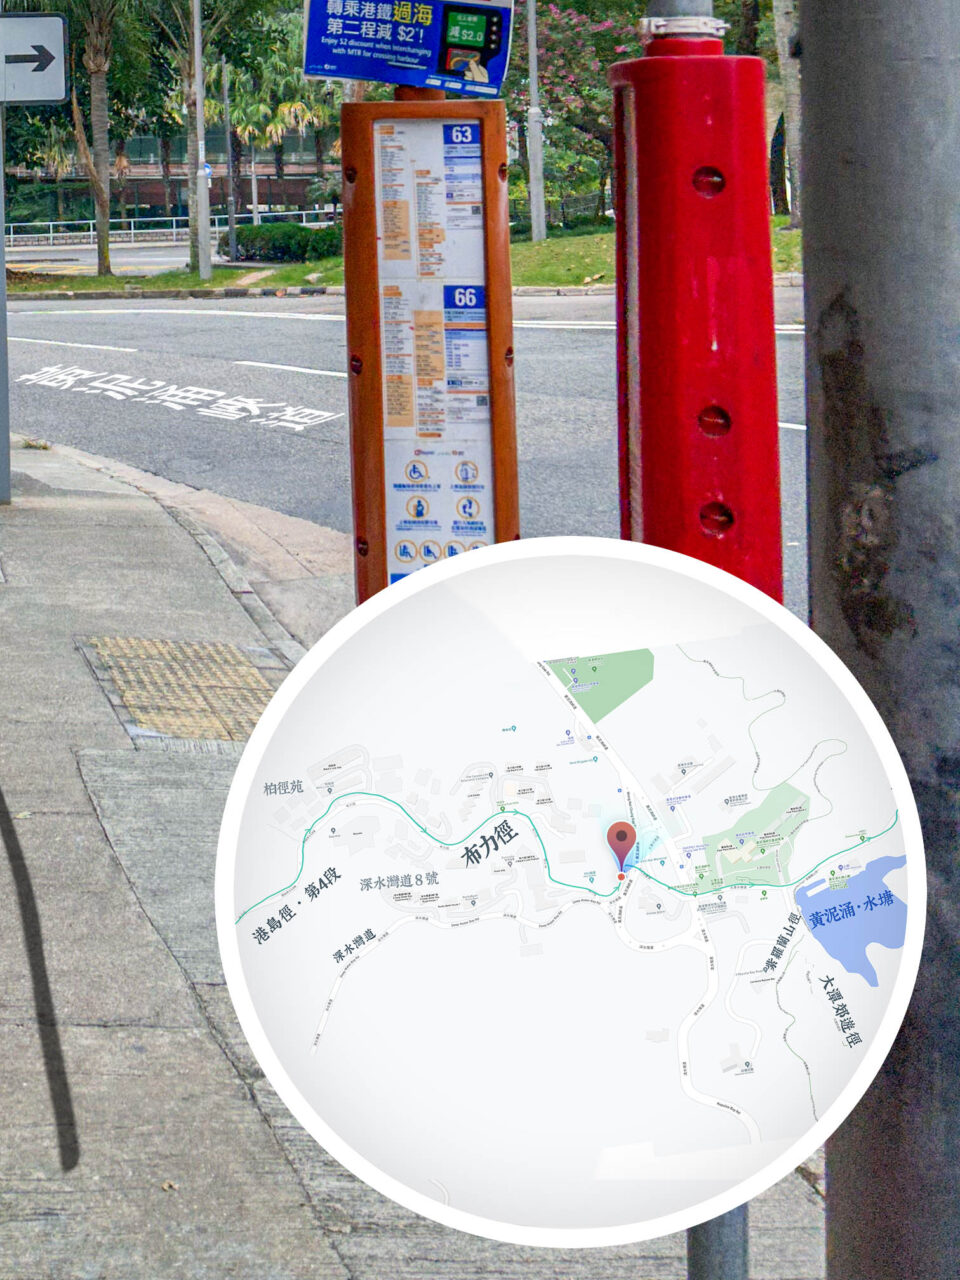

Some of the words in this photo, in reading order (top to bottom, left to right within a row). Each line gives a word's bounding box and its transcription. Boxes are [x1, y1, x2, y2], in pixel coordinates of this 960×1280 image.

[326, 18, 393, 41] 第二程減
[451, 126, 472, 143] 63
[454, 288, 477, 307] 66
